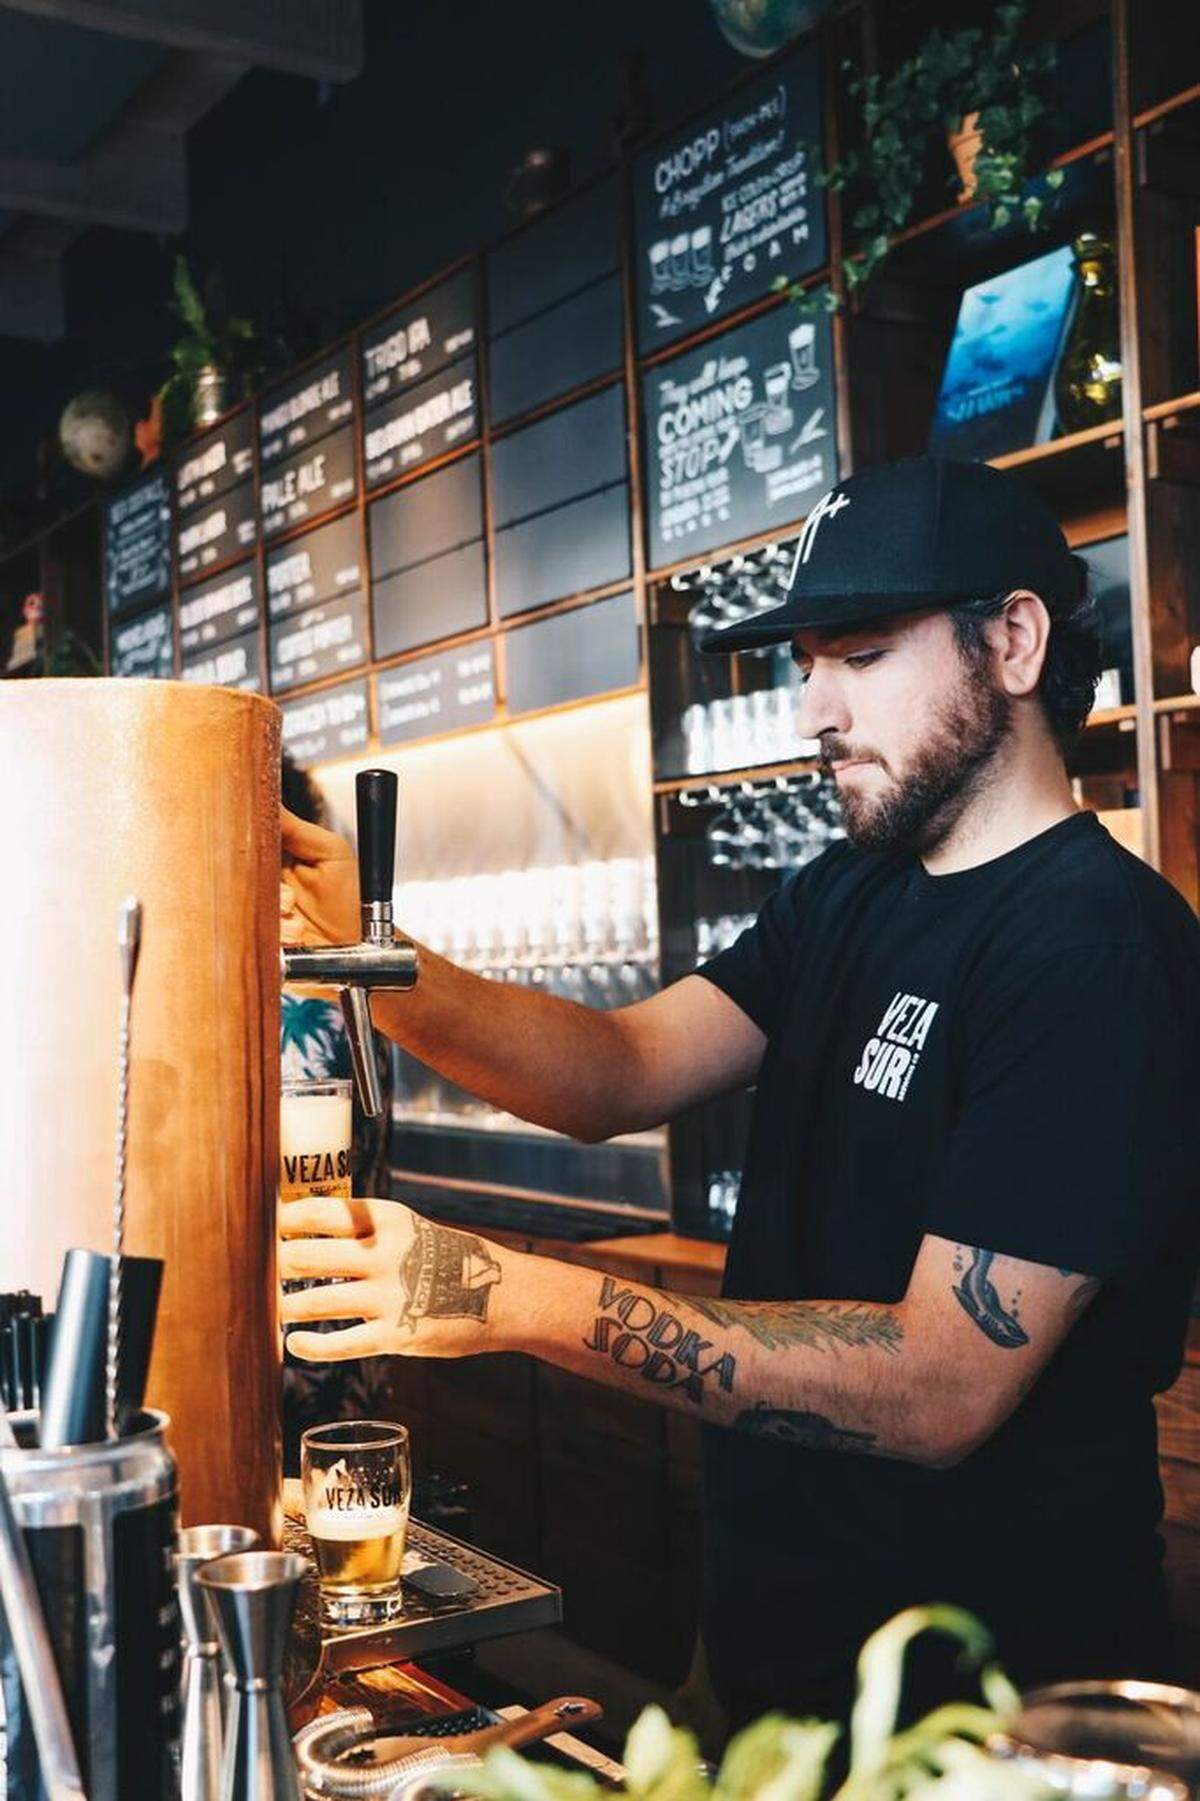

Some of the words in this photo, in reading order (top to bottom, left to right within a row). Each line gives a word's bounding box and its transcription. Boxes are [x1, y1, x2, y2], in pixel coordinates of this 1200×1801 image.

[657, 375, 754, 445] COMING
[877, 992, 939, 1051] VEZA
[283, 1152, 335, 1184] VEZA
[583, 1317, 704, 1403] SODA
[598, 1276, 736, 1393] VODKA
[325, 1486, 367, 1511] VEZA
